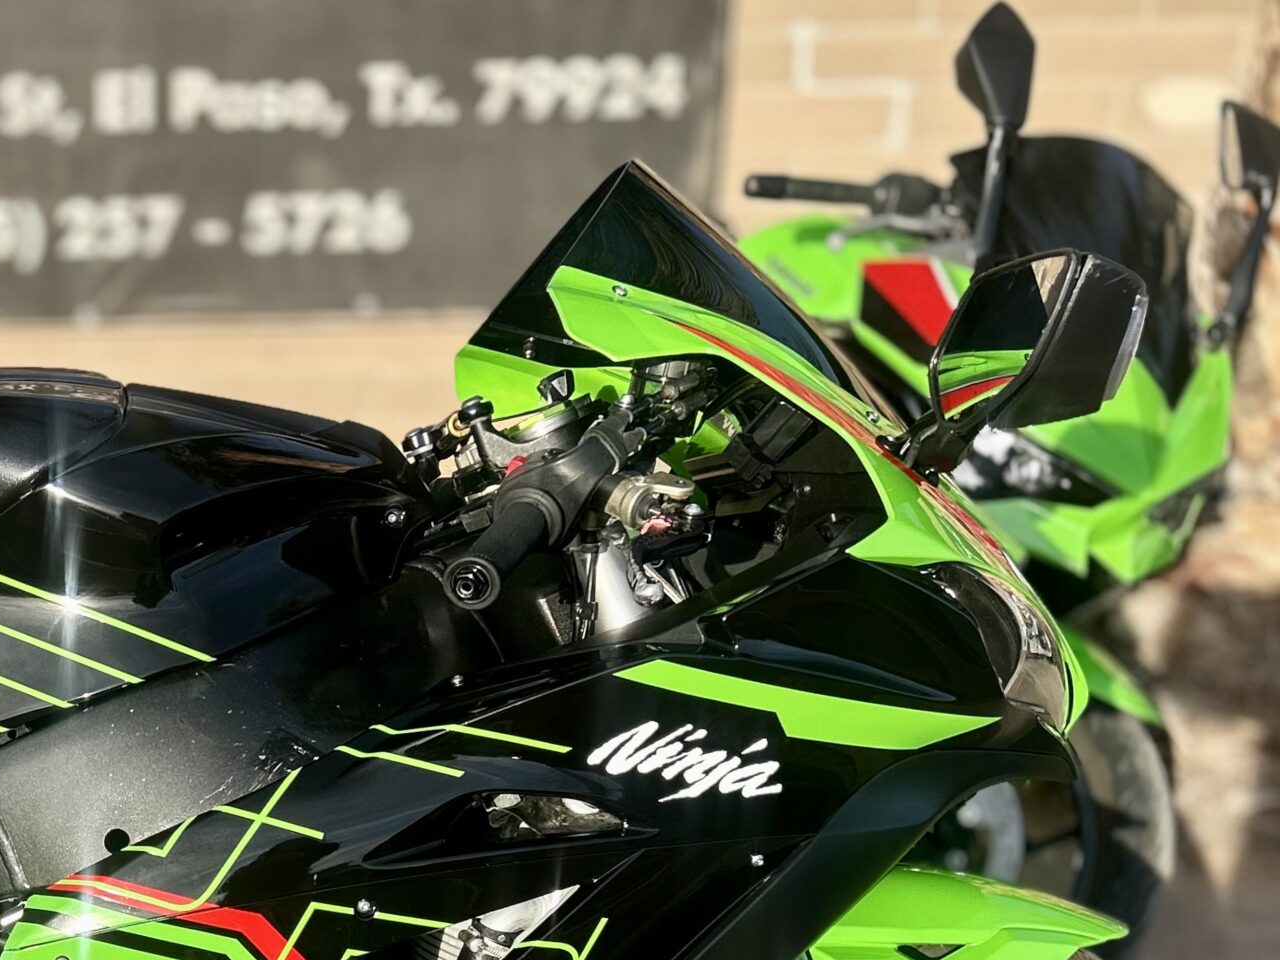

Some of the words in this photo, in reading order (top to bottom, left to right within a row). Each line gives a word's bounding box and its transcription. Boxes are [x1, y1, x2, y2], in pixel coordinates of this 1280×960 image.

[94, 66, 158, 134] El
[473, 54, 689, 122] 79924
[54, 193, 183, 260] 257
[241, 188, 412, 256] 5726
[587, 721, 783, 803] Ninja
